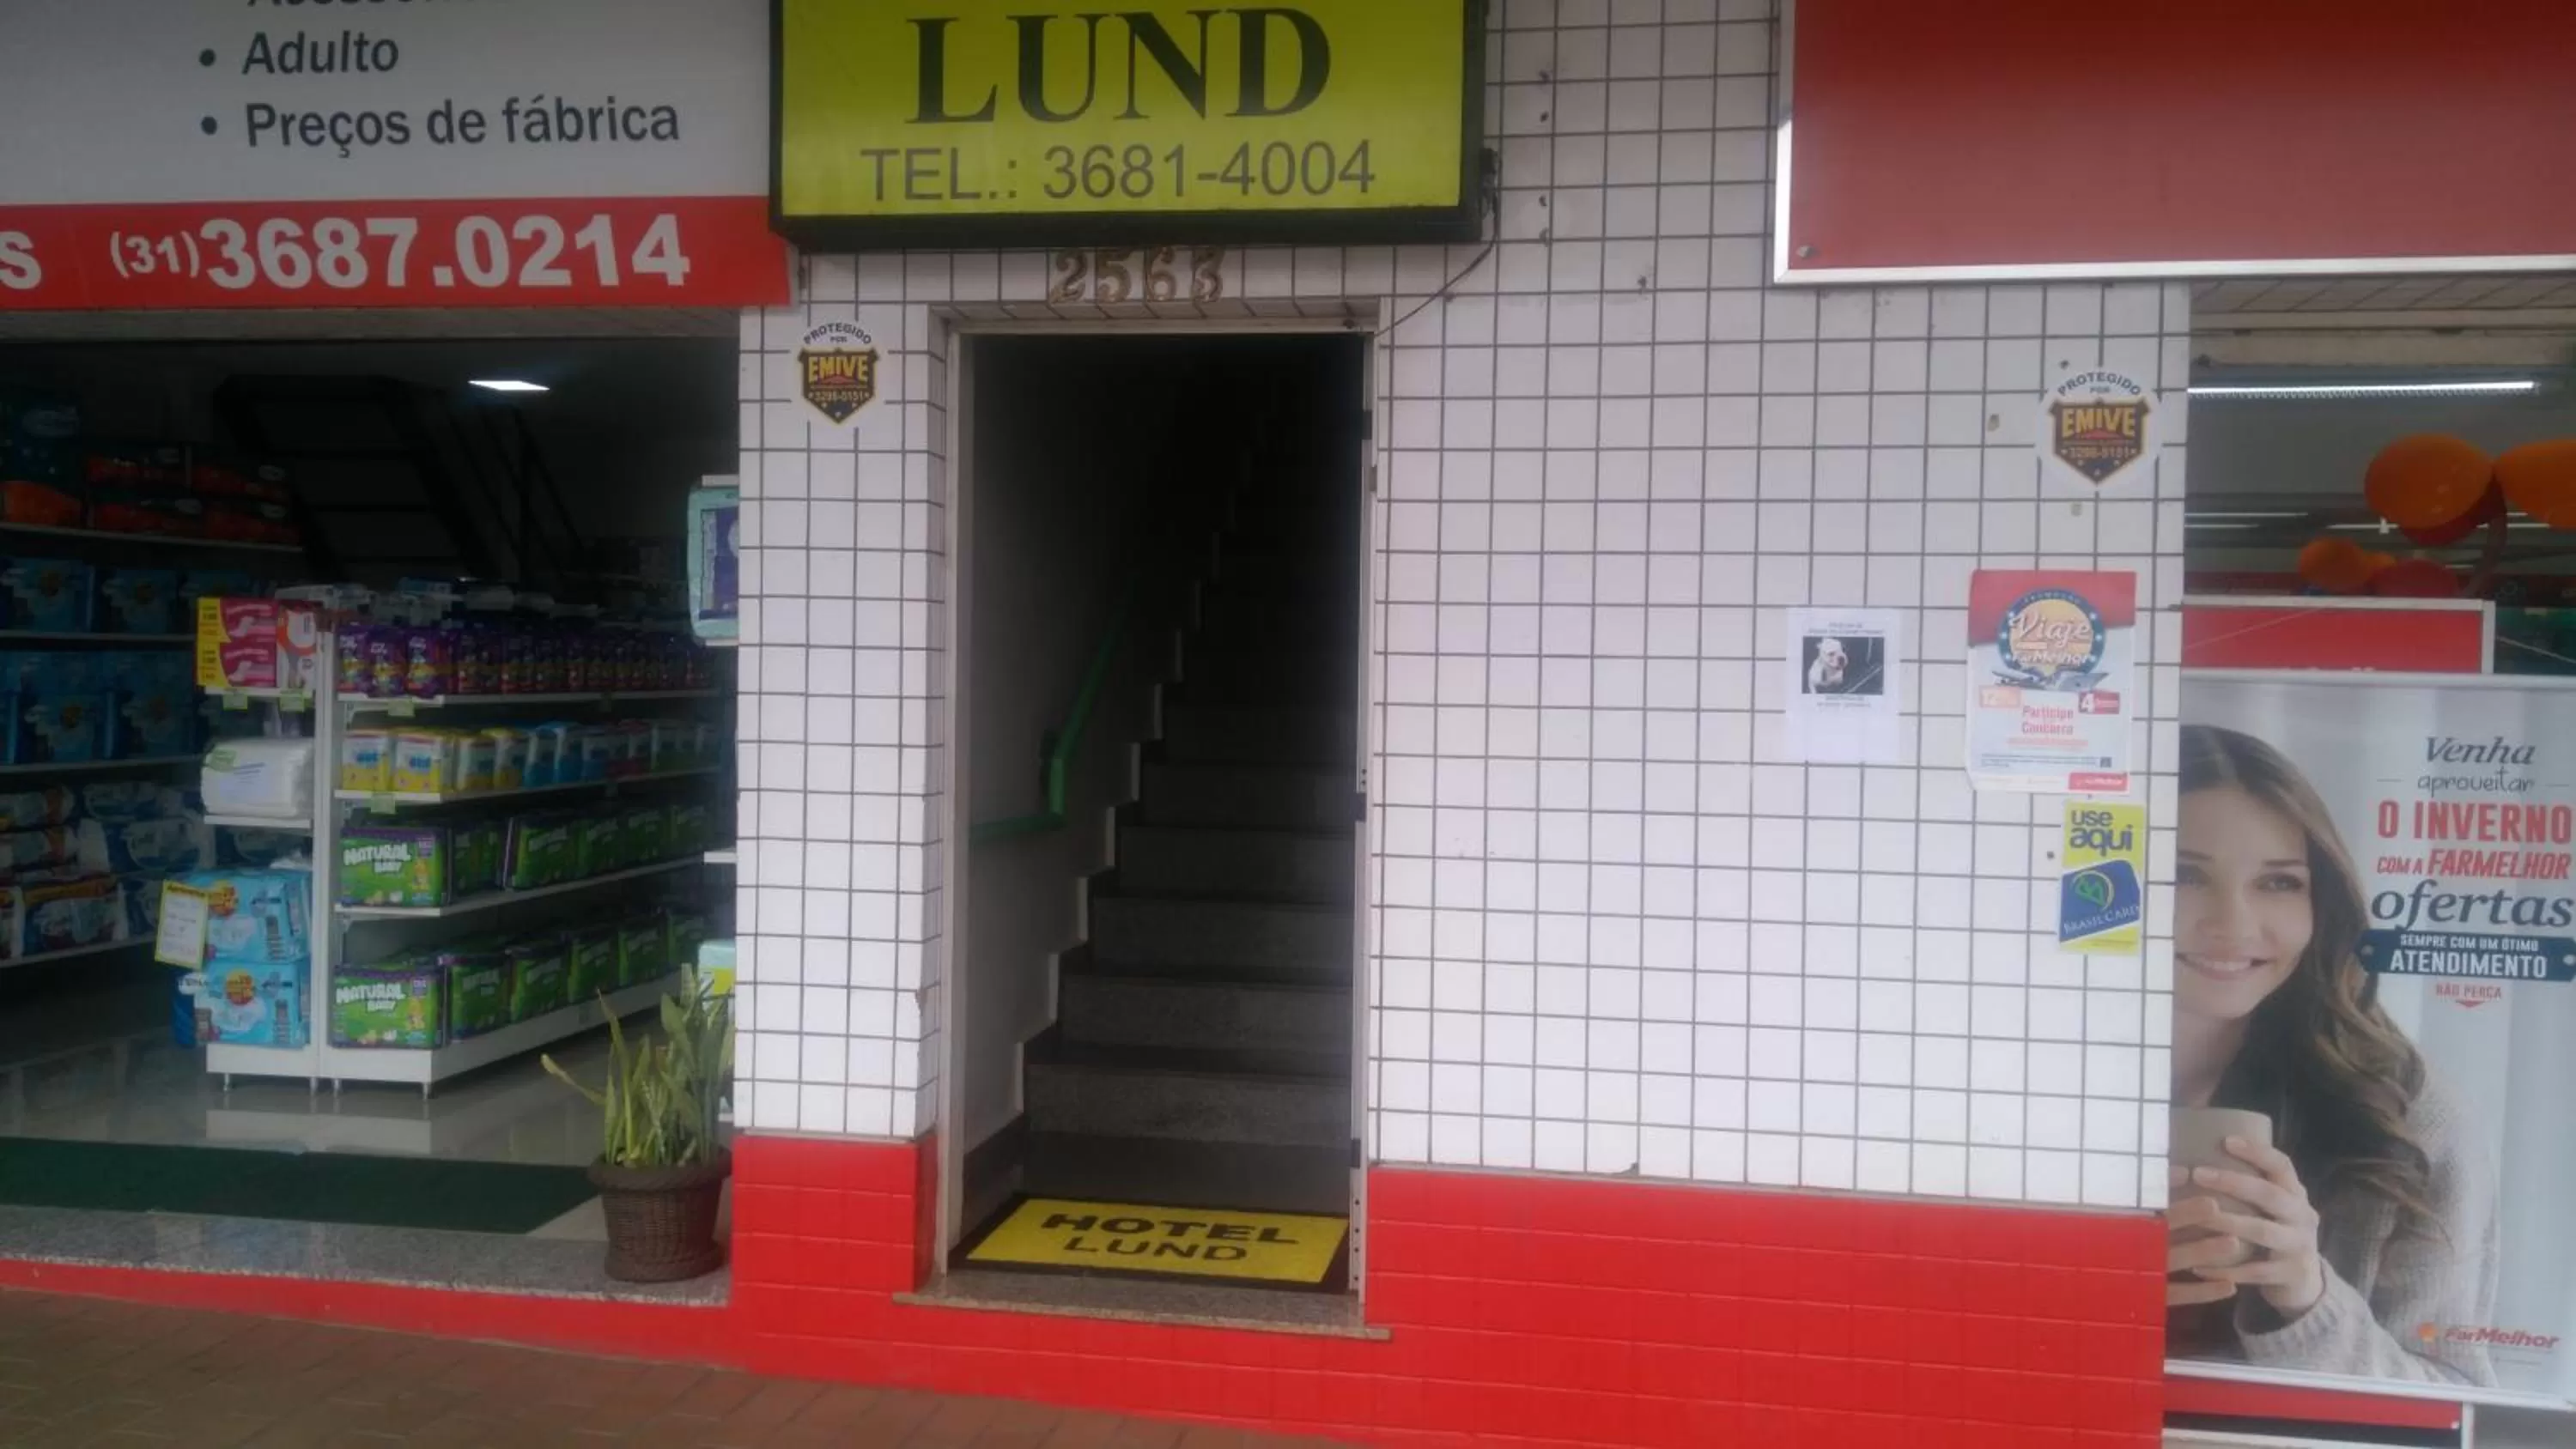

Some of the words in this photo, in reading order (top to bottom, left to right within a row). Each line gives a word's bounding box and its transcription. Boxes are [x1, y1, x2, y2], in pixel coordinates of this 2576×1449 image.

[242, 30, 399, 75] Adulto
[905, 7, 1331, 125] LUND
[245, 102, 411, 158] Preços
[427, 100, 486, 145] de
[502, 94, 681, 144] fábrica
[860, 148, 1019, 202] TEL.:
[1042, 139, 1376, 199] 3681-4004
[1048, 246, 1224, 302] 2563
[804, 323, 872, 344] PROTEGIDO
[808, 355, 869, 383] EMIVE
[2057, 372, 2142, 397] PROTEGIDO
[2063, 407, 2136, 439] EMIVE
[2425, 736, 2536, 765] Venha
[2417, 767, 2535, 797] aproveitar
[2070, 809, 2114, 827] use
[2378, 799, 2399, 840] O
[2414, 800, 2573, 845] INVERNO
[2069, 824, 2134, 857] aqui
[2376, 856, 2410, 875] COM
[2426, 848, 2573, 880] FARMELHOR
[2371, 878, 2575, 931] ofertas
[2400, 933, 2447, 949] SEMPRE
[2450, 935, 2477, 949] COM
[2479, 936, 2500, 950] UM
[2390, 949, 2548, 979] ATENDIMENTO
[1041, 1213, 1300, 1246] HOTEL
[1063, 1237, 1249, 1262] LUND
